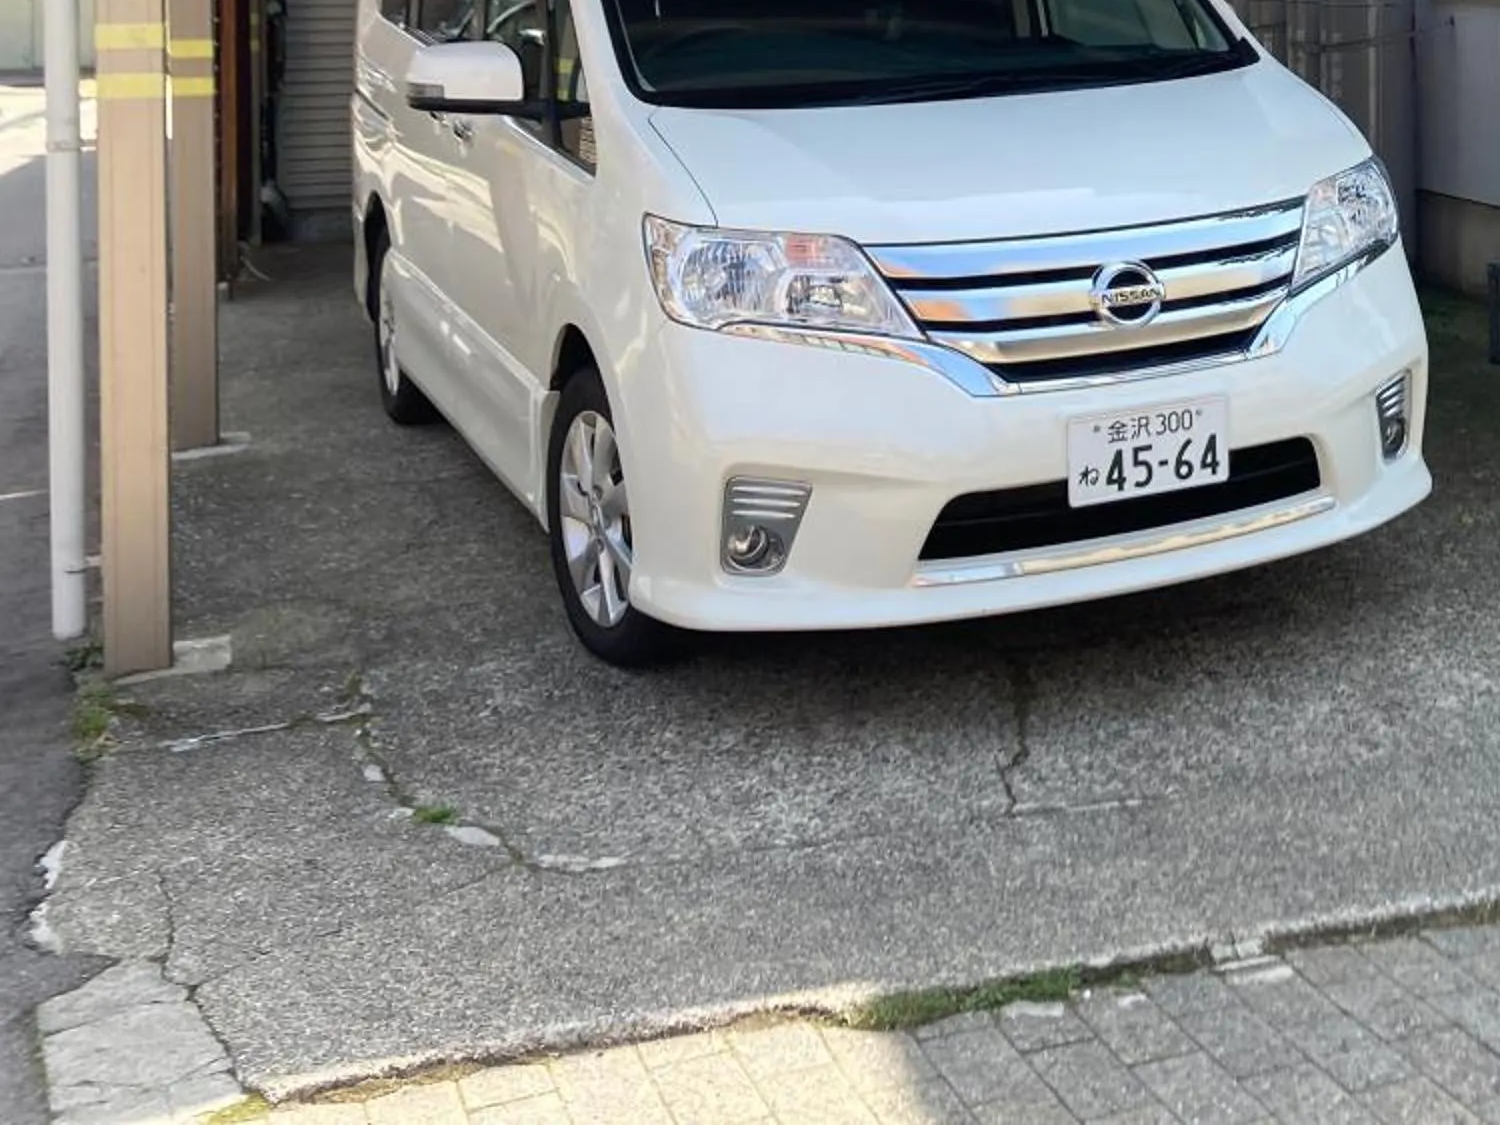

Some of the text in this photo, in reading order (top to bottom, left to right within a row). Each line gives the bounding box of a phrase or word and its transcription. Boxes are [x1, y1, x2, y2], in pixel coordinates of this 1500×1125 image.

[1101, 287, 1161, 306] NISSAN
[1079, 433, 1220, 492] ね 45-64
